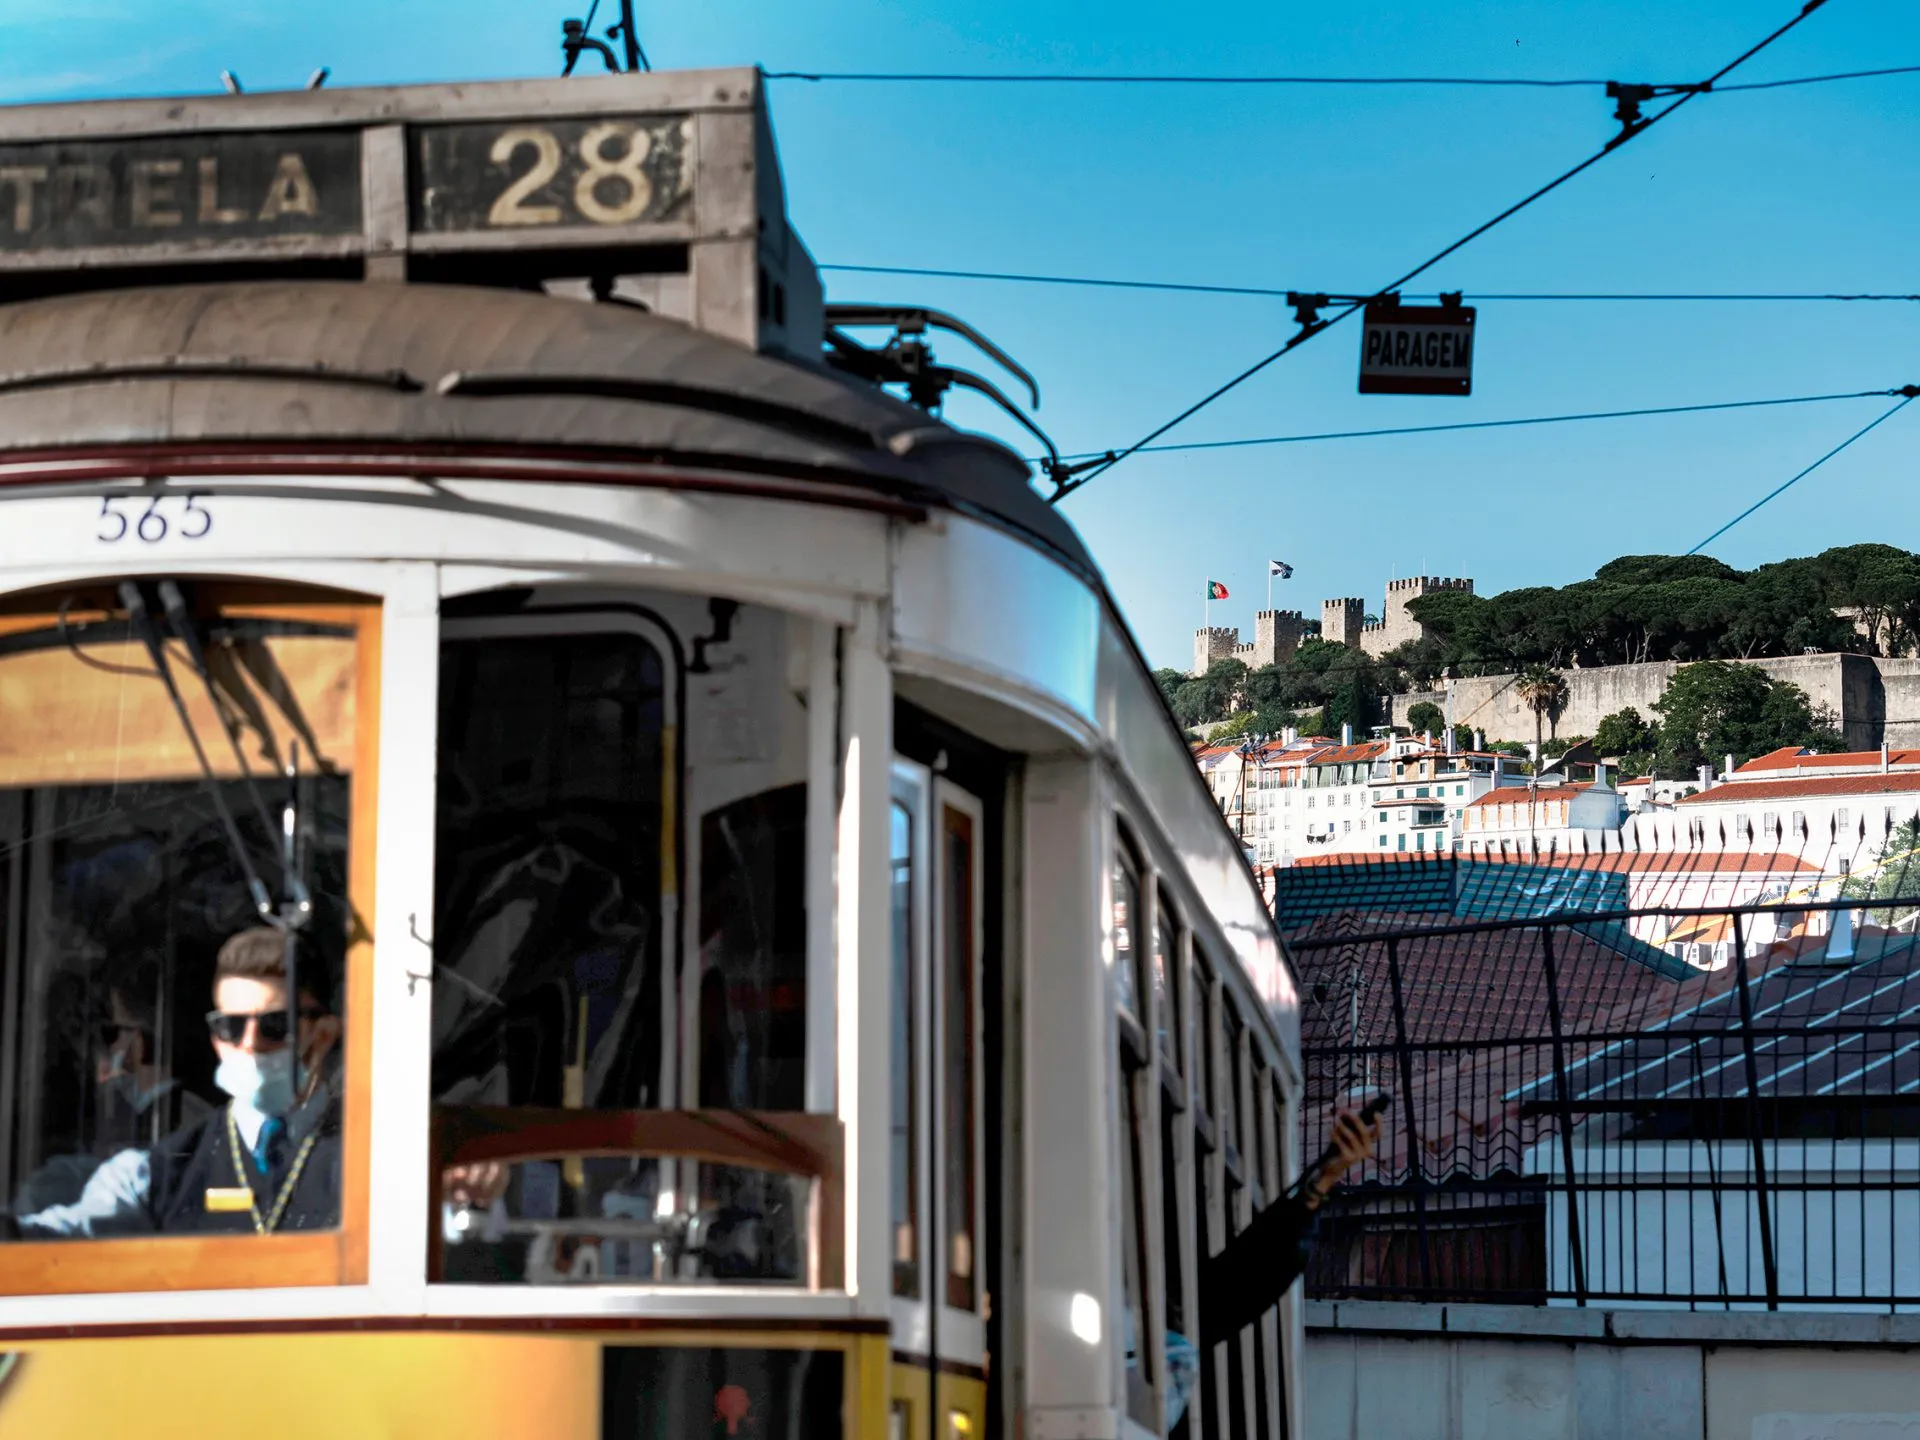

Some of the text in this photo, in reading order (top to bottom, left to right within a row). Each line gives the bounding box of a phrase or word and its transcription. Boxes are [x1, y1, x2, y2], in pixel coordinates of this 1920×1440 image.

[489, 123, 652, 223] 28
[1366, 329, 1471, 368] PARAGEM
[98, 489, 214, 541] 565
